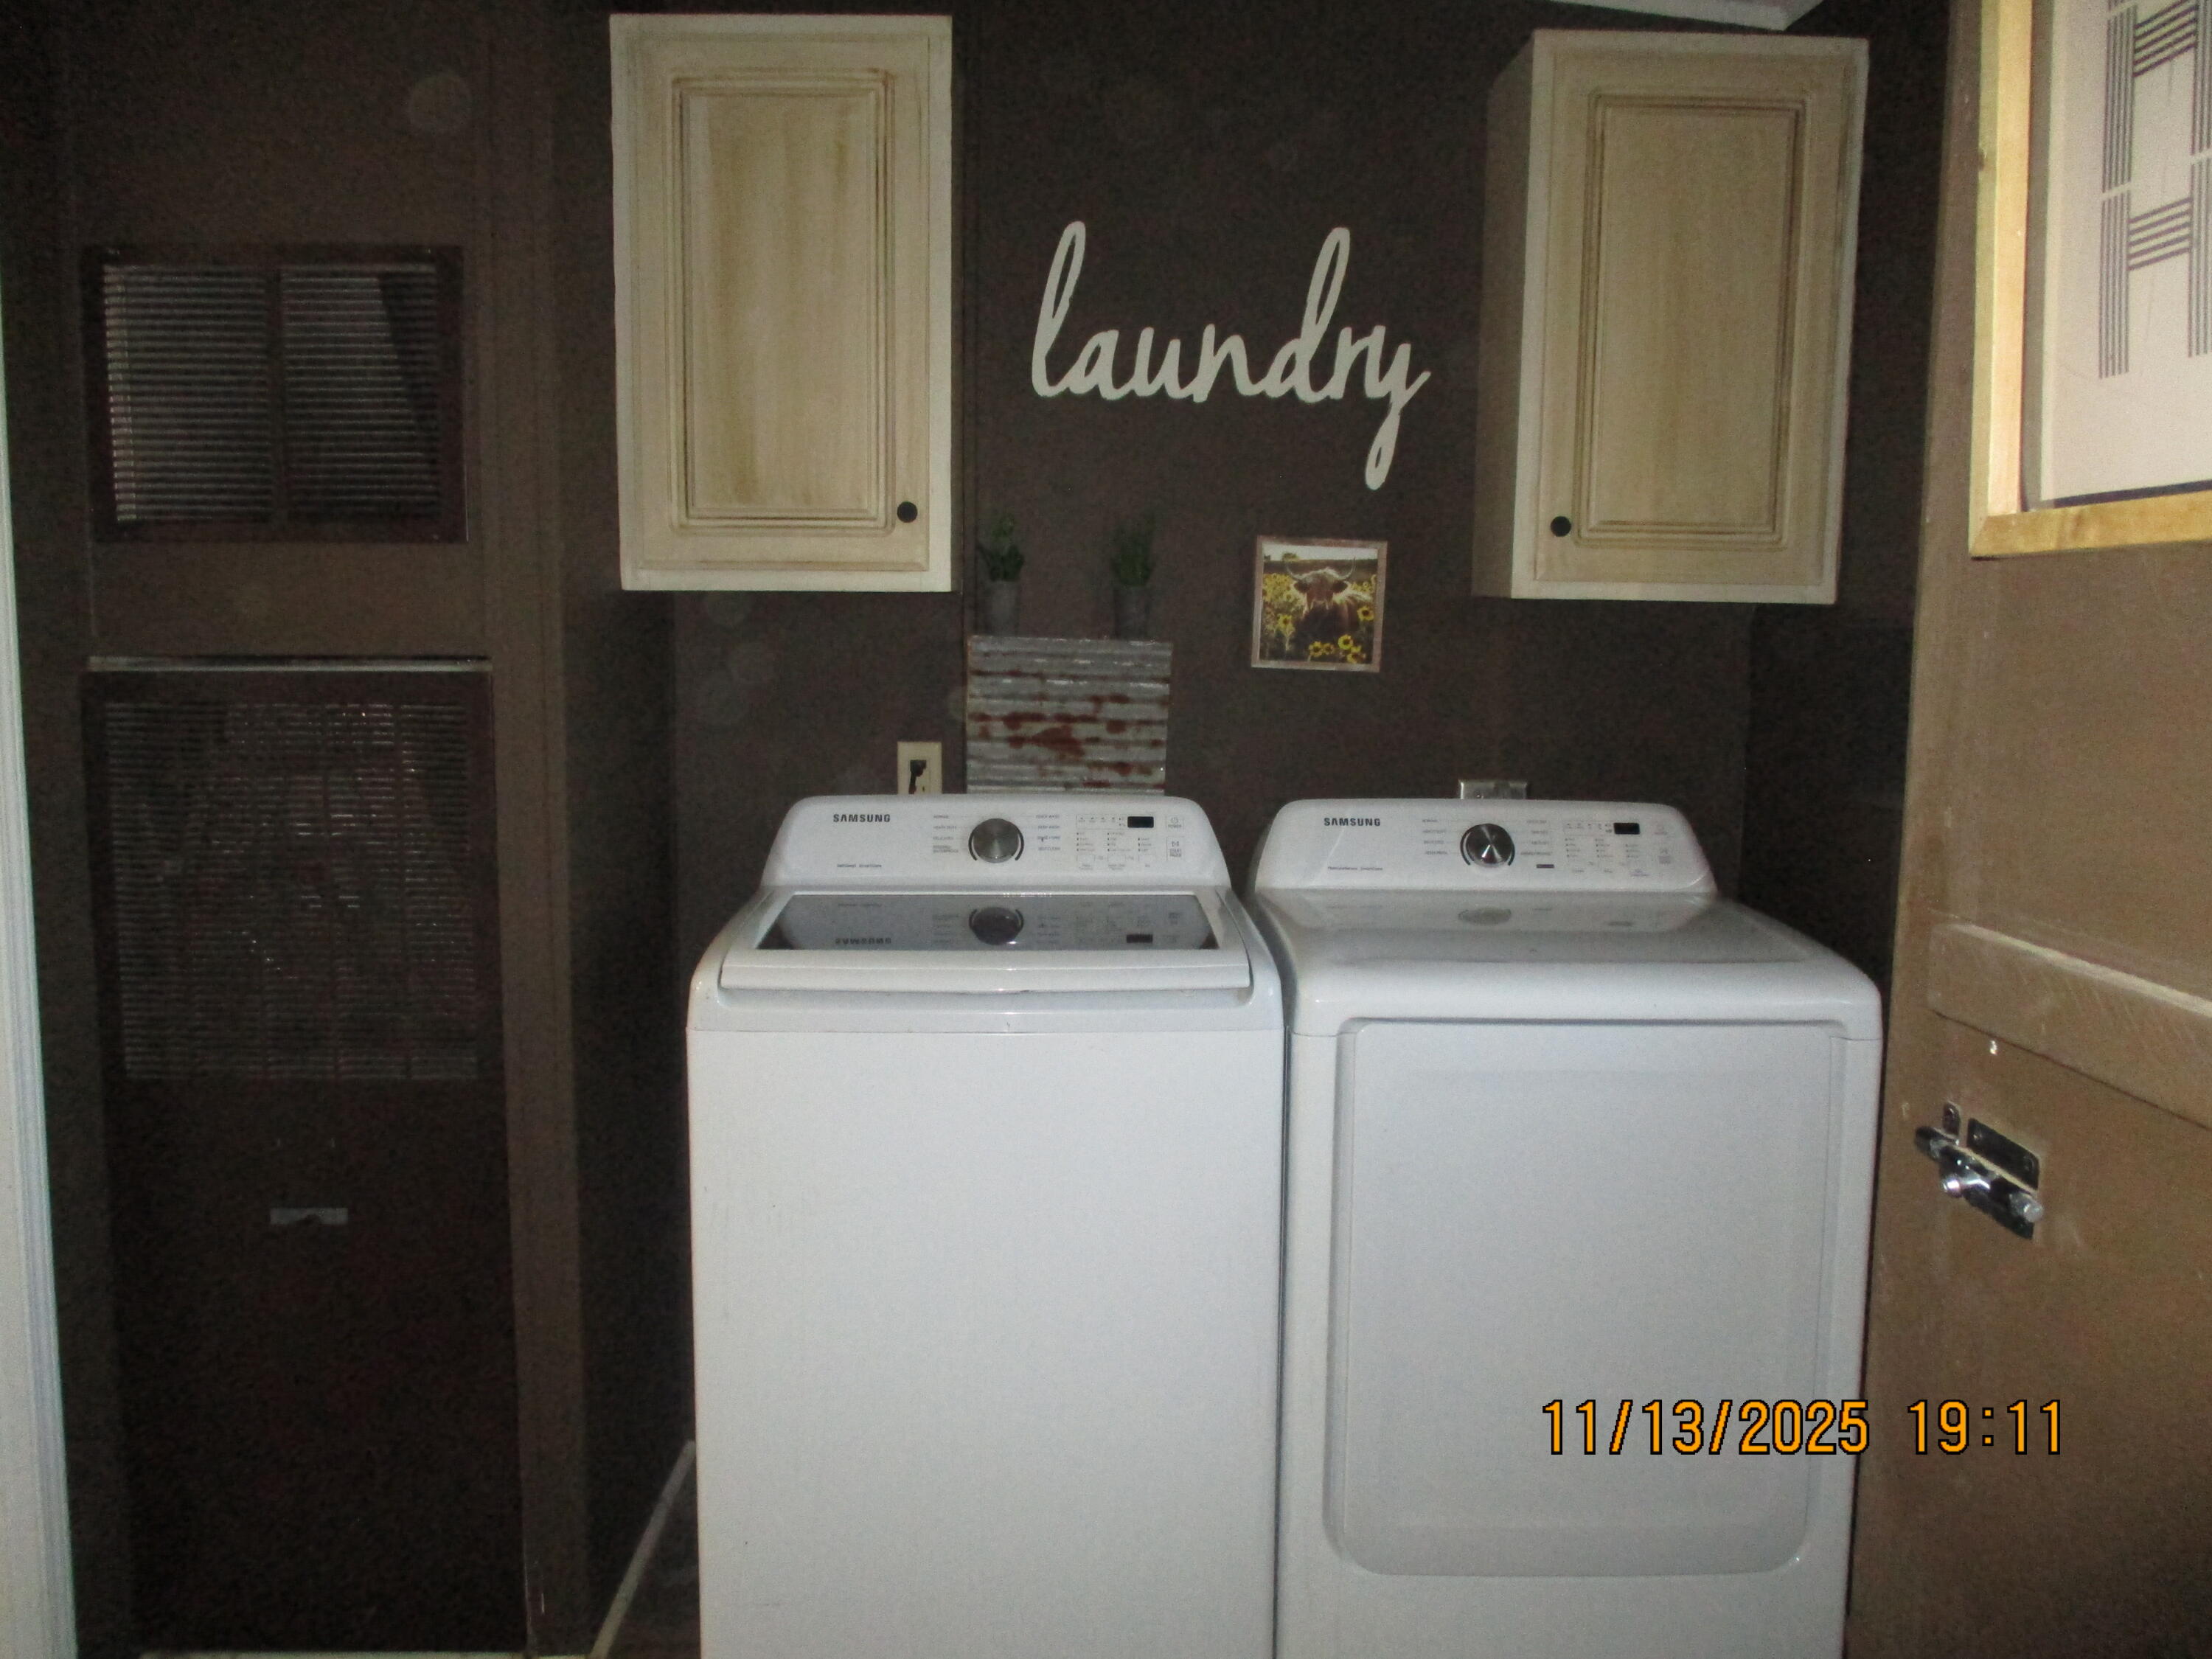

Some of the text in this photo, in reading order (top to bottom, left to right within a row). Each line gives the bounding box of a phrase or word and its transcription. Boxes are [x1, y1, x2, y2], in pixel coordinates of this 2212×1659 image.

[1032, 220, 1431, 491] laundry
[832, 813, 891, 823] SAMSUNG
[1324, 817, 1381, 827] SAMSUNG
